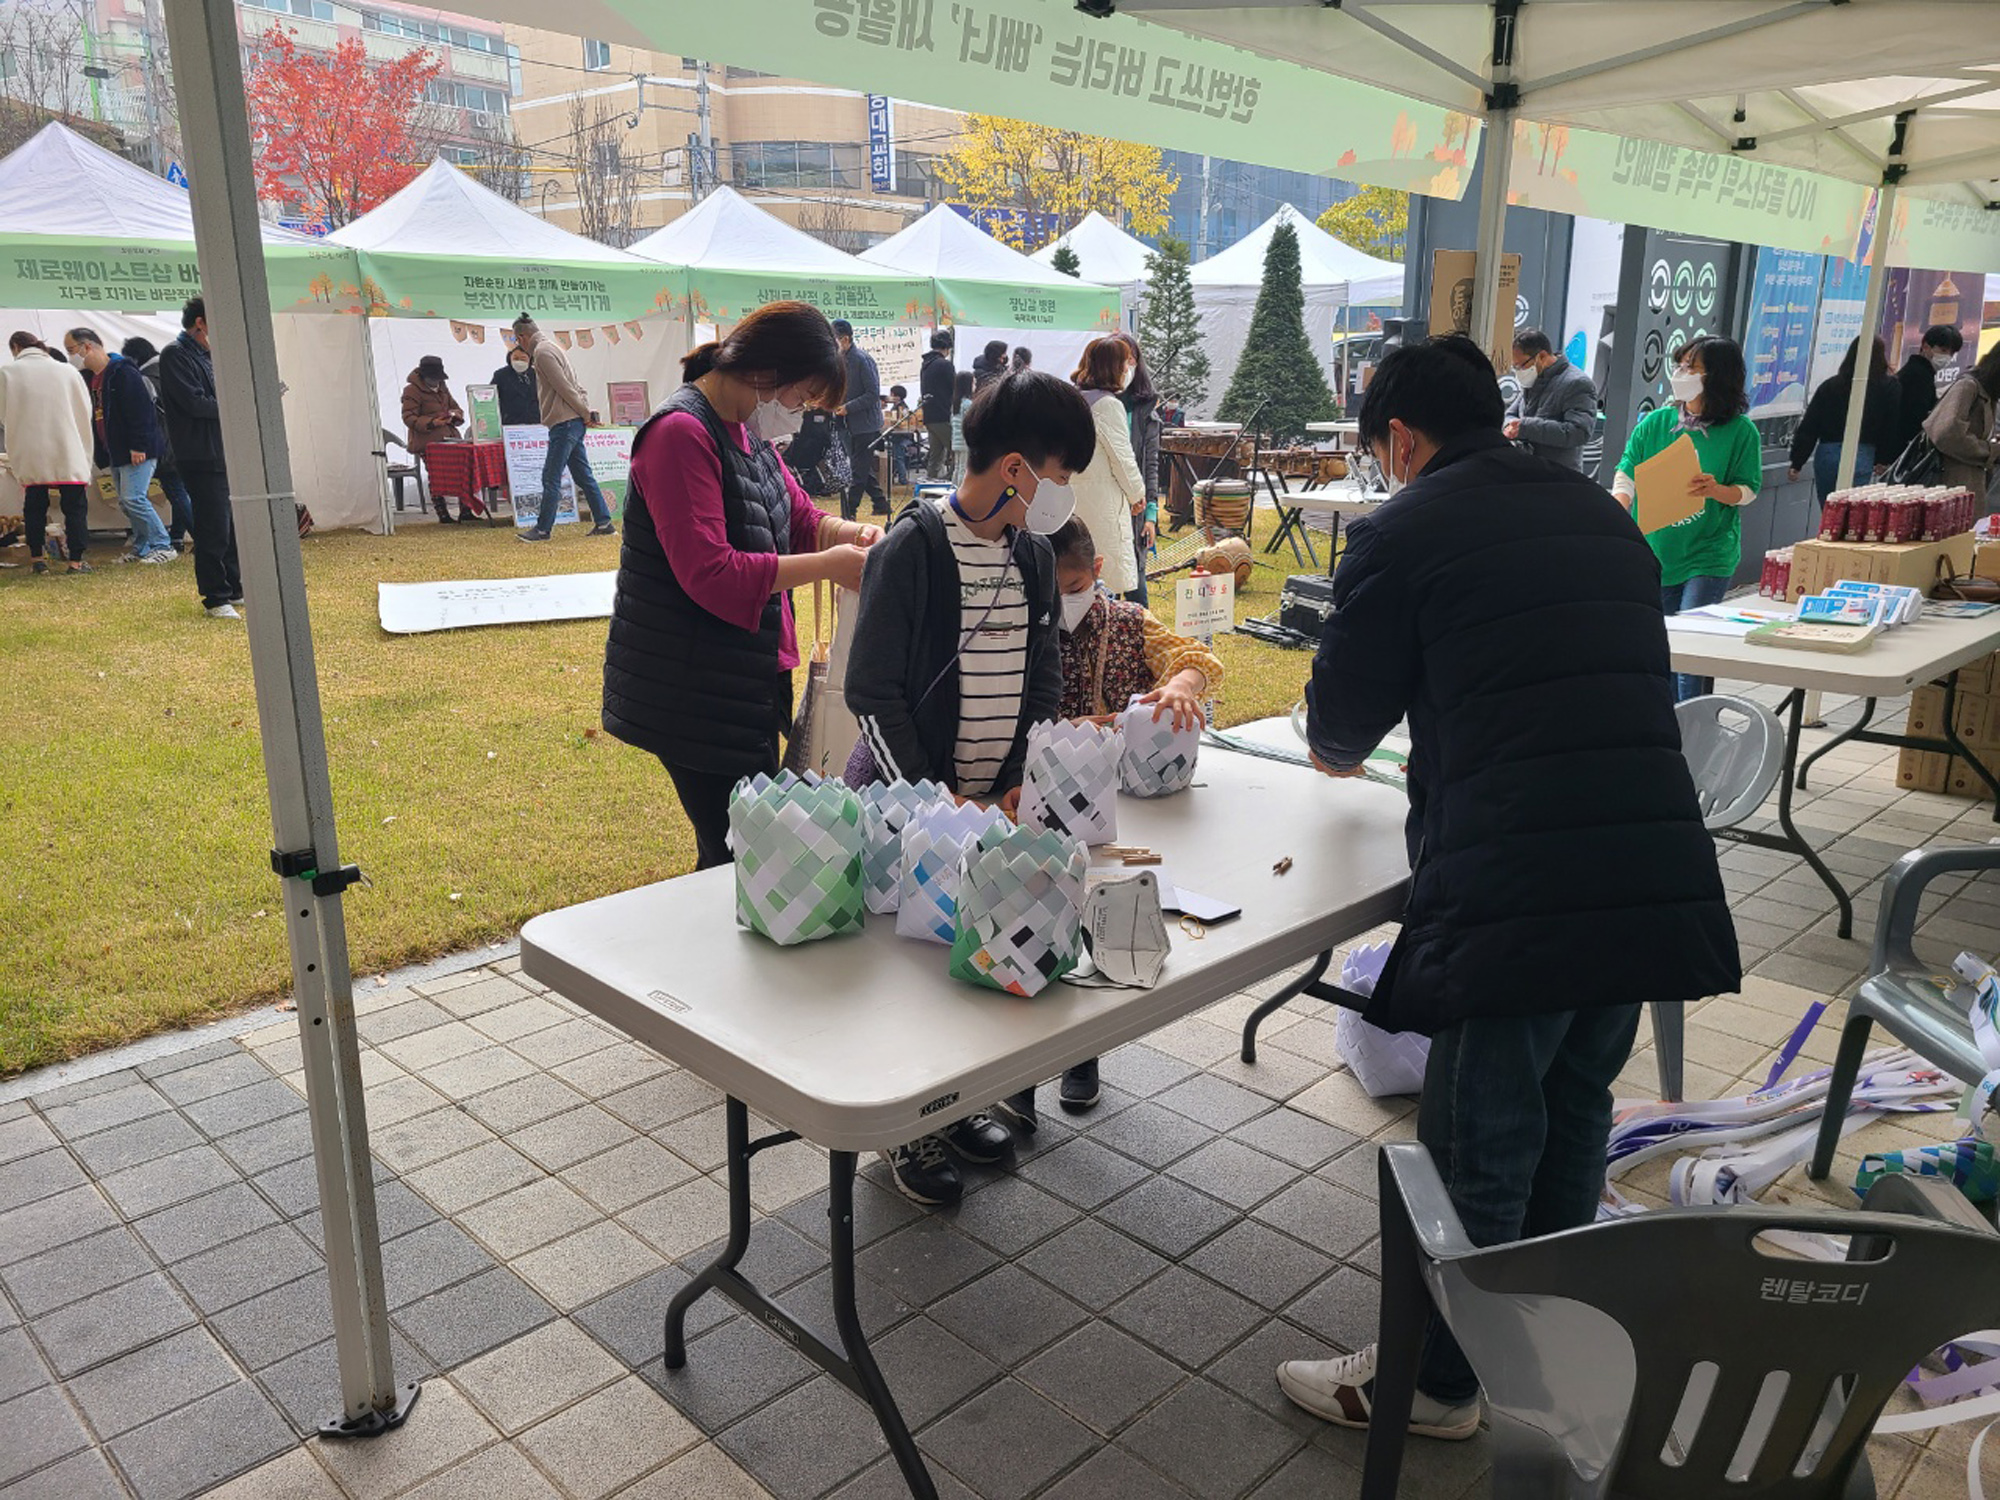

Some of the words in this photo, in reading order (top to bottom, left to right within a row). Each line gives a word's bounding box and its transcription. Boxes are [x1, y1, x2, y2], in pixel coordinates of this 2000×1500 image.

[14, 258, 173, 283] 제로웨이스트샵
[59, 286, 103, 301] 지구를
[105, 286, 148, 301] 지키는
[464, 292, 549, 312] 부천YMCA
[552, 293, 612, 312] 녹색가게
[1008, 297, 1037, 312] 장난감
[1038, 299, 1057, 313] 병원
[1760, 1277, 1869, 1306] 렌탈코디
